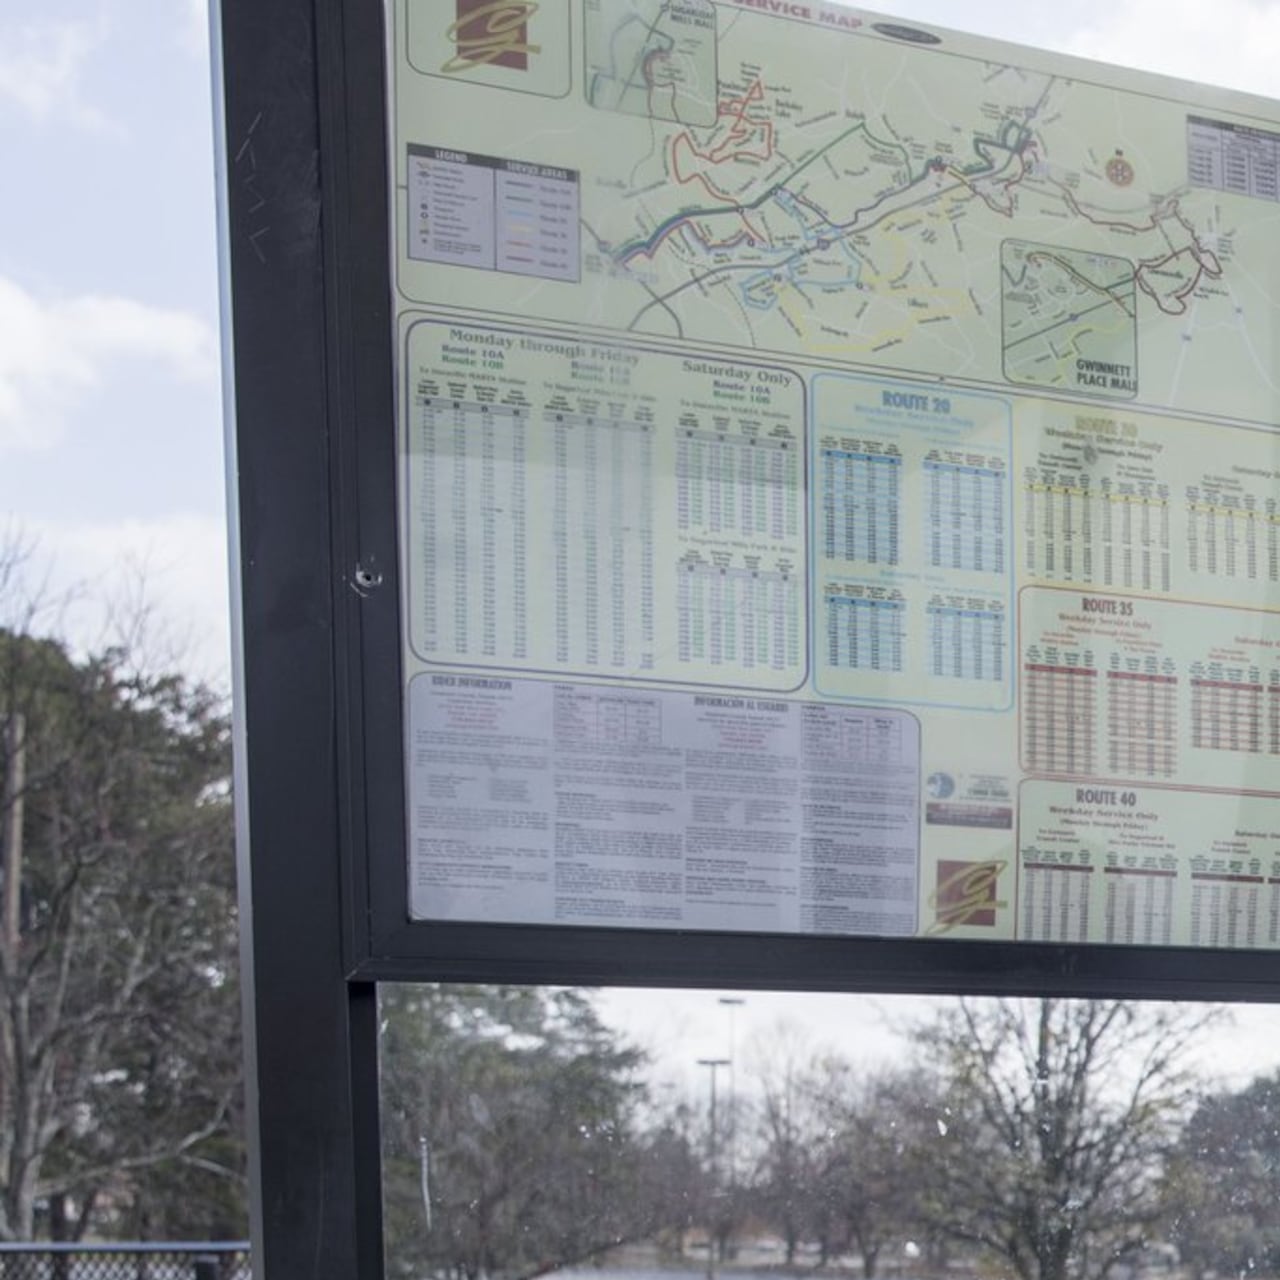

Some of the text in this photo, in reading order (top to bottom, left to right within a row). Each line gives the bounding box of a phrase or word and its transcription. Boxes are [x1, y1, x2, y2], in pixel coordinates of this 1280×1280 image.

[450, 328, 640, 368] Monday through Friday
[481, 349, 505, 360] 10A
[683, 360, 792, 387] Saturday Only
[1076, 359, 1131, 378] GWINNETT
[1077, 372, 1107, 388] PLACE
[882, 390, 929, 411] ROUTE
[1082, 598, 1134, 616] ROUTE 35
[1076, 788, 1137, 806] ROUTE 40
